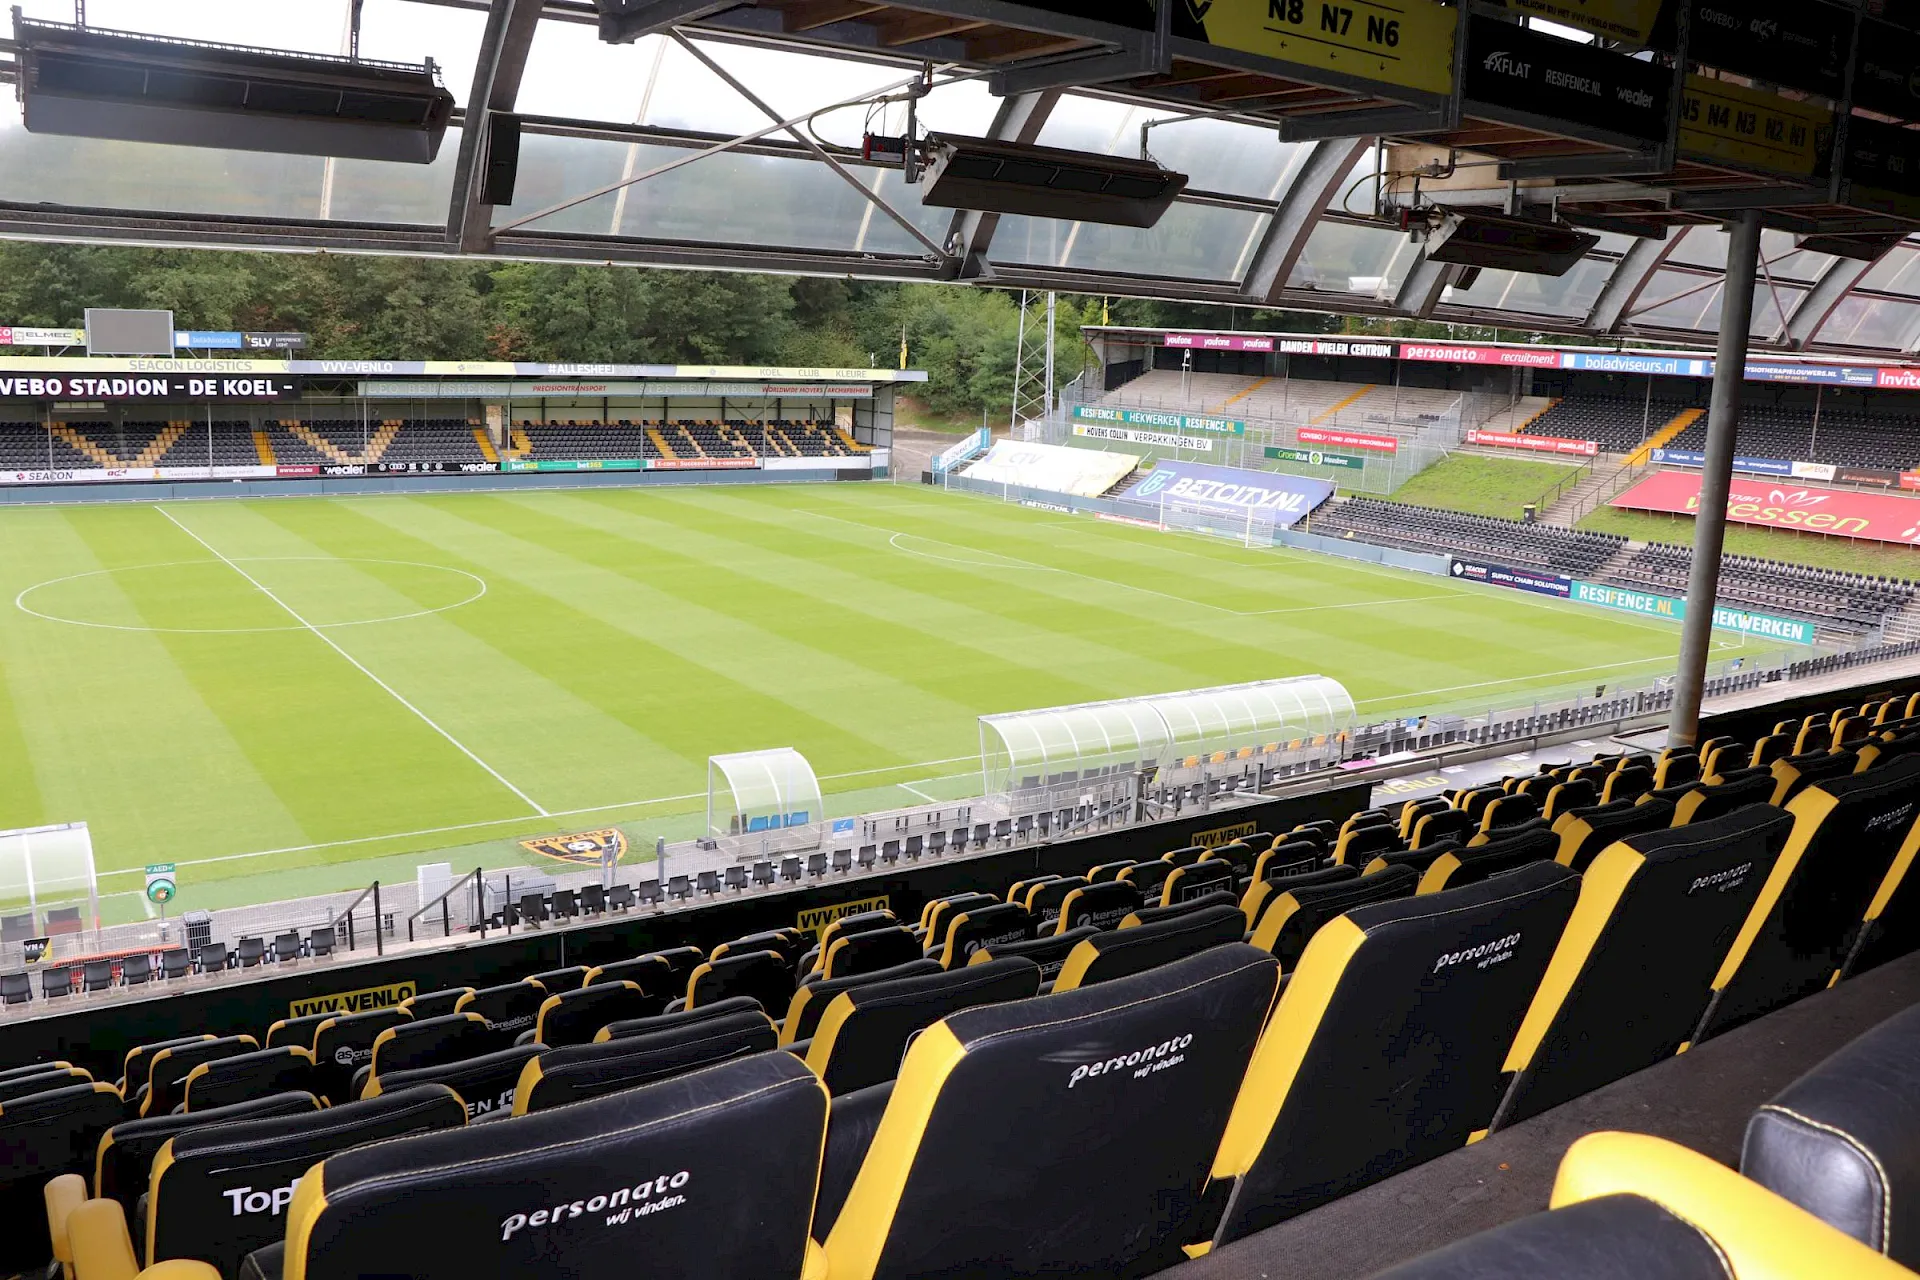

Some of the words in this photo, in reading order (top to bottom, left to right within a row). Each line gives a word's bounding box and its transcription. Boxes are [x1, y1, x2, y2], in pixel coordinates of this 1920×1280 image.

[1268, 0, 1305, 25] N8
[1321, 3, 1353, 36] N7
[1367, 15, 1400, 48] N6
[1700, 7, 1737, 29] COVEBO
[1545, 68, 1602, 97] RESIFENCE.NL
[1616, 85, 1654, 109] wealer
[1707, 103, 1731, 128] N4
[1736, 110, 1756, 134] N3
[1765, 117, 1784, 142] N2
[1789, 124, 1806, 147] N1
[25, 331, 72, 339] ELMEC
[250, 337, 273, 347] SLV
[1166, 336, 1192, 345] youfone
[1203, 338, 1230, 347] youfone
[1242, 340, 1270, 349] youfone
[1280, 340, 1313, 353] BANDEN
[1317, 342, 1348, 355] WIELEN
[1350, 344, 1391, 357] CENTRUM
[129, 360, 183, 371] SEACON
[187, 360, 252, 371] LOGISTICS
[1500, 352, 1554, 365] recruitment
[1585, 355, 1677, 374] boladviseurs.nl
[321, 361, 393, 373] VVV-VENLO
[760, 369, 781, 377] KOEL
[798, 369, 820, 378] CLUB
[835, 370, 867, 378] KLEURE
[70, 379, 168, 396] STADION
[189, 380, 217, 396] DE
[224, 379, 278, 396] KOEL
[368, 383, 399, 395] LEO
[408, 383, 496, 395] BEURSKENS
[639, 384, 672, 393] STEF
[762, 386, 799, 394] WORLDWIDE
[1080, 408, 1124, 421] RESIFENCE.NL
[1129, 412, 1180, 426] HEKWERKEN
[1185, 417, 1236, 432] RESIFENCE.NL
[1086, 427, 1108, 439] HOVENS
[1109, 429, 1128, 440] COLLIN
[1133, 433, 1194, 448] VERPAKKINGEN
[1196, 440, 1208, 449] BV
[324, 465, 365, 475] wealer
[460, 462, 497, 472] wealer
[511, 461, 538, 471] bet365
[577, 460, 602, 469] bet365
[717, 458, 754, 466] e-commerce
[28, 472, 74, 481] SEACON
[1170, 477, 1306, 512] BETCITY.NL
[1026, 500, 1069, 513] BETCITY.NL
[1465, 564, 1487, 573] SEACON
[1491, 572, 1514, 582] SUPPLY
[1514, 576, 1533, 586] CHAIN
[1534, 579, 1569, 592] SOLUTIONS
[1579, 585, 1674, 616] RESIFENCE.NL
[527, 829, 613, 846] VVV-VENLO
[1193, 824, 1255, 847] VVV-VENLO
[799, 898, 888, 930] VVV-VENLO
[1092, 905, 1134, 921] kersten
[981, 928, 1025, 948] kersten
[1433, 932, 1521, 974] personato
[293, 984, 413, 1014] VVV-VENLO
[1067, 1033, 1194, 1089] personato
[1133, 1063, 1152, 1079] wij
[501, 1170, 690, 1241] personato
[605, 1208, 632, 1227] wij
